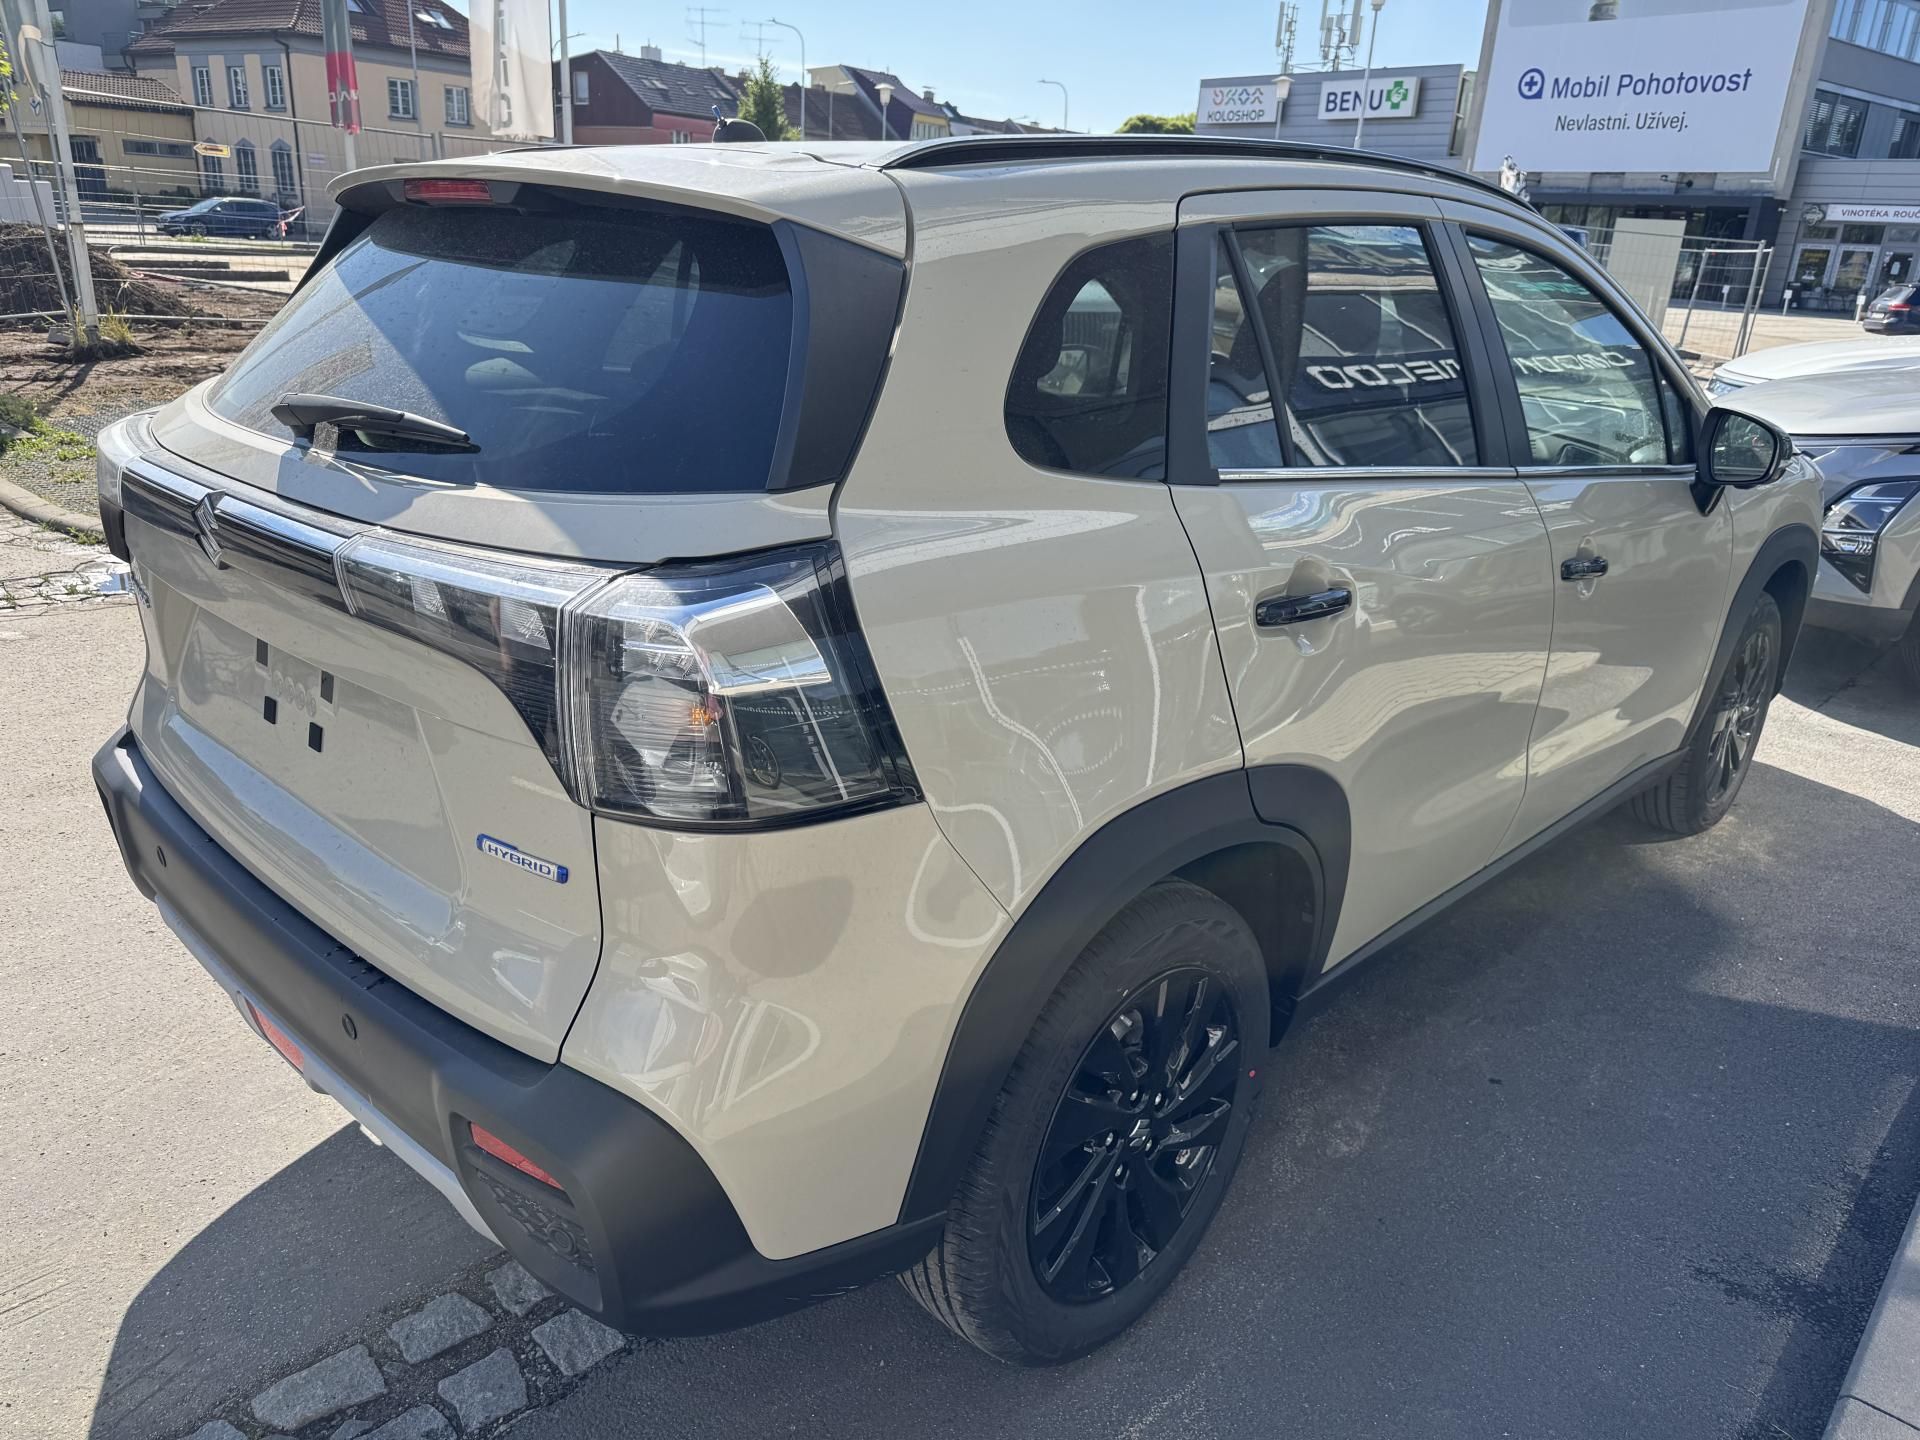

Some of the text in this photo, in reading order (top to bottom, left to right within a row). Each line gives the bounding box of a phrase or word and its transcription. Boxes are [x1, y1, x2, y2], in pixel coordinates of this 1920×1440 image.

[1551, 68, 1753, 99] Mobil Pohotovost
[1325, 89, 1384, 112] BENU
[1207, 109, 1265, 122] KOLOSHOP
[1554, 111, 1689, 133] Nevlastni. Užívej.
[1841, 208, 1889, 218] VINOTÉKA
[488, 843, 552, 876] HYBRID
